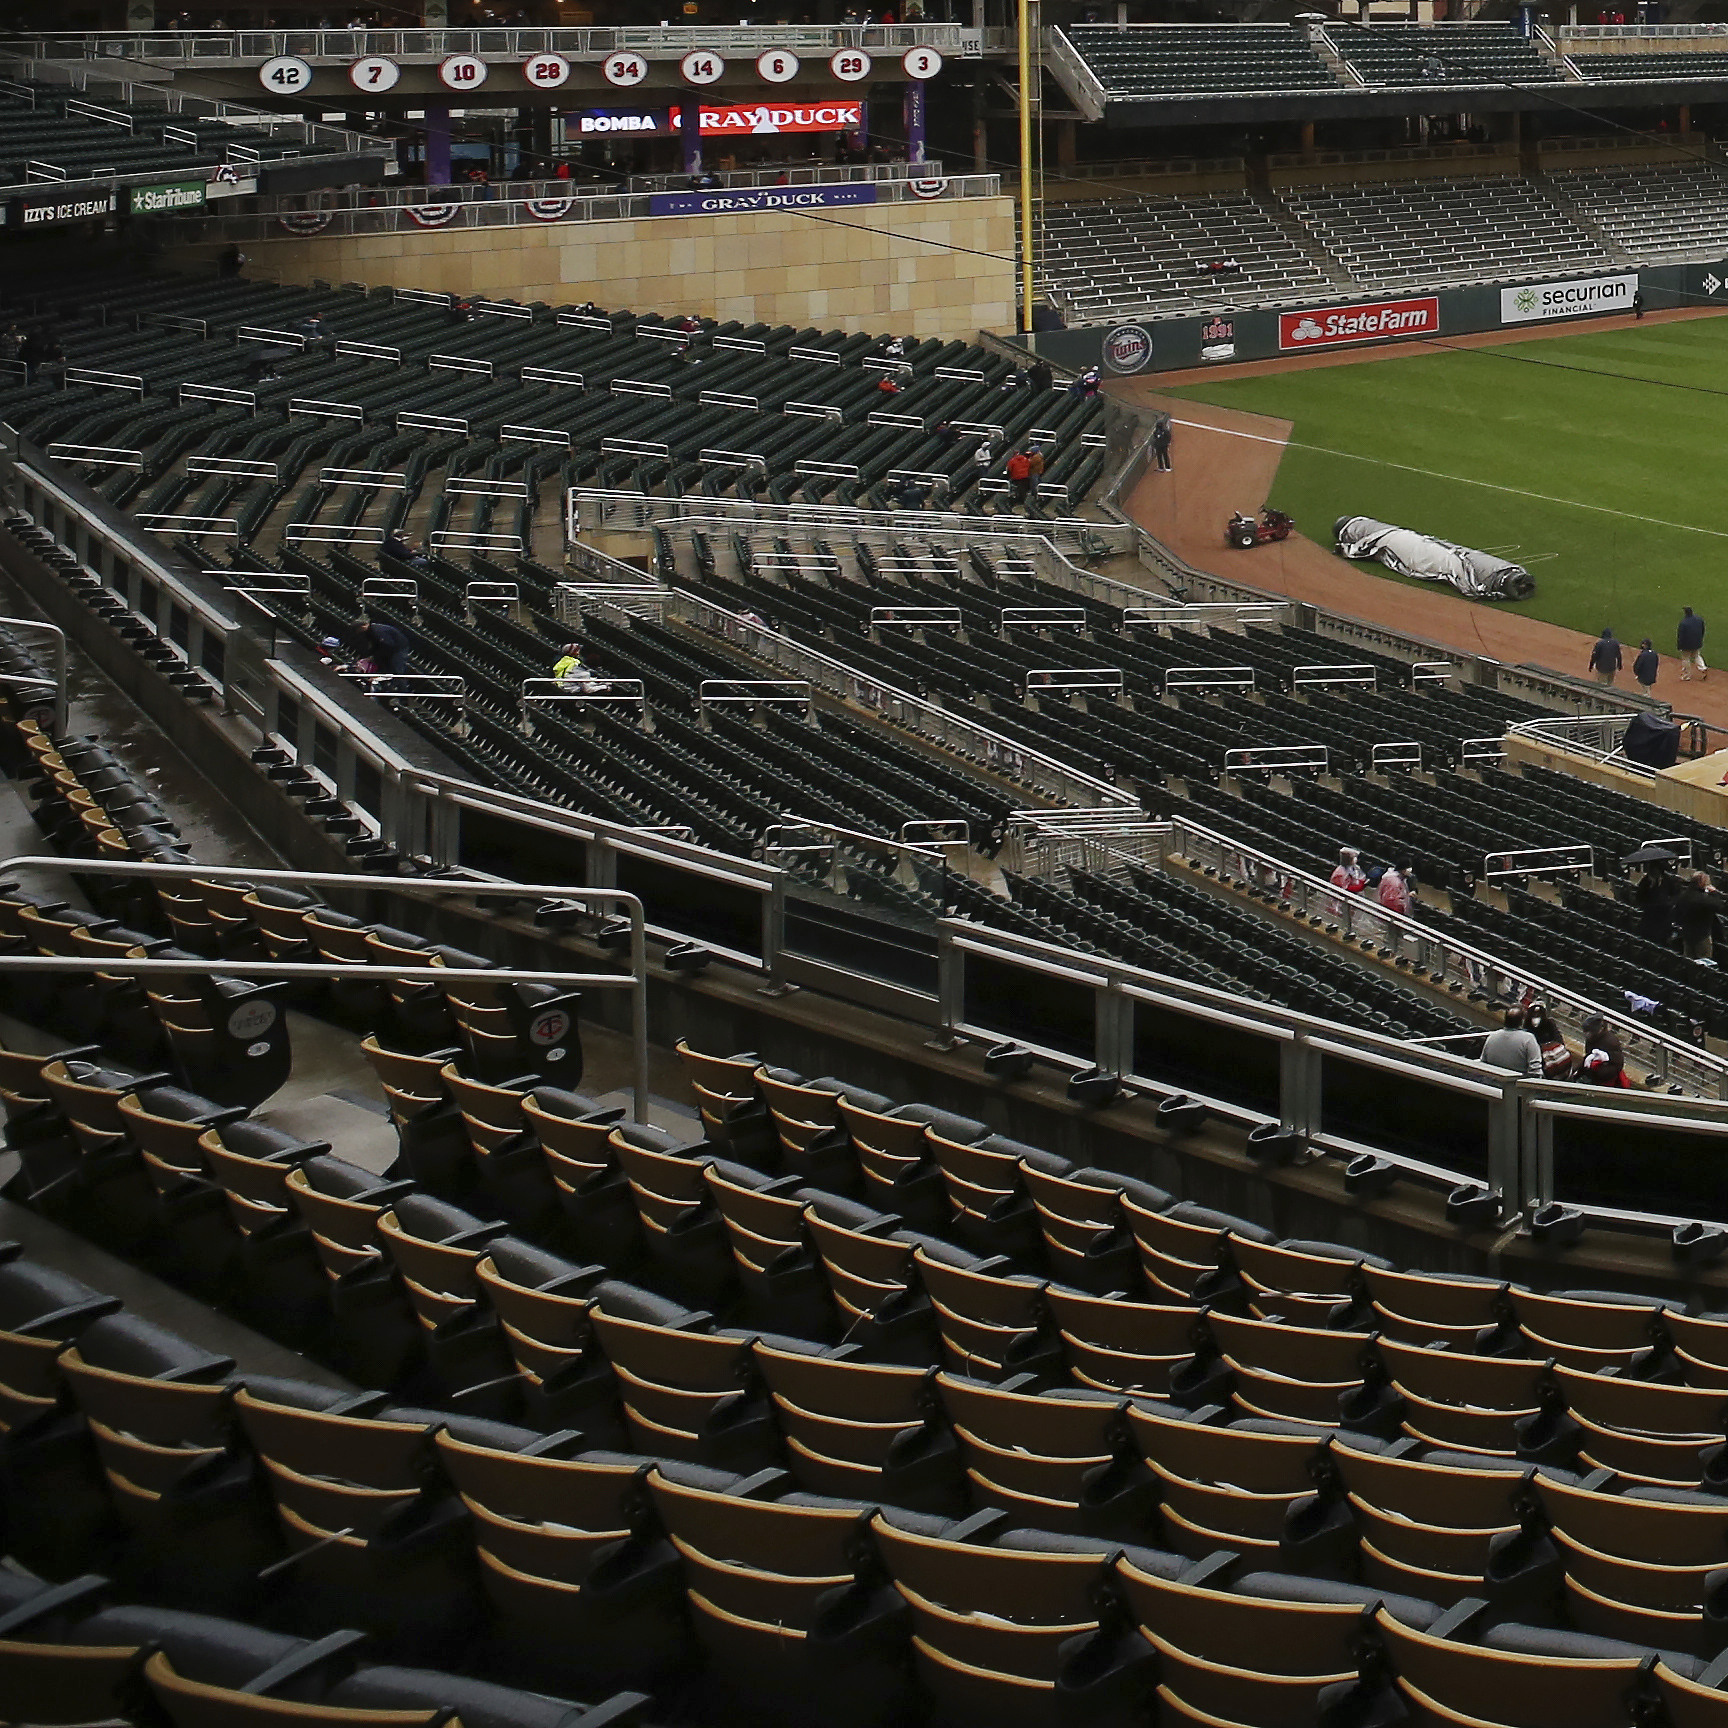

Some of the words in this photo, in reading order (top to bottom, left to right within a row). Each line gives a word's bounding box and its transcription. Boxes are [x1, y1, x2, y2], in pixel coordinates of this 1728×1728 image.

[535, 62, 560, 79] 28
[613, 62, 638, 78] 34
[693, 60, 713, 76] 14
[773, 59, 784, 74] 6
[841, 58, 862, 73] 29
[918, 56, 929, 71] 3
[271, 67, 300, 85] 42
[368, 66, 382, 84] 7
[453, 64, 475, 82] 10
[581, 116, 656, 132] BOMBA
[772, 107, 860, 125] DUCK
[145, 187, 202, 210] StarTribune
[766, 193, 825, 208] DUCK
[57, 204, 72, 219] ICE
[74, 200, 108, 215] CREAM
[1542, 282, 1626, 306] securian
[1543, 304, 1593, 316] FINANCIAL
[1203, 323, 1233, 340] 1991
